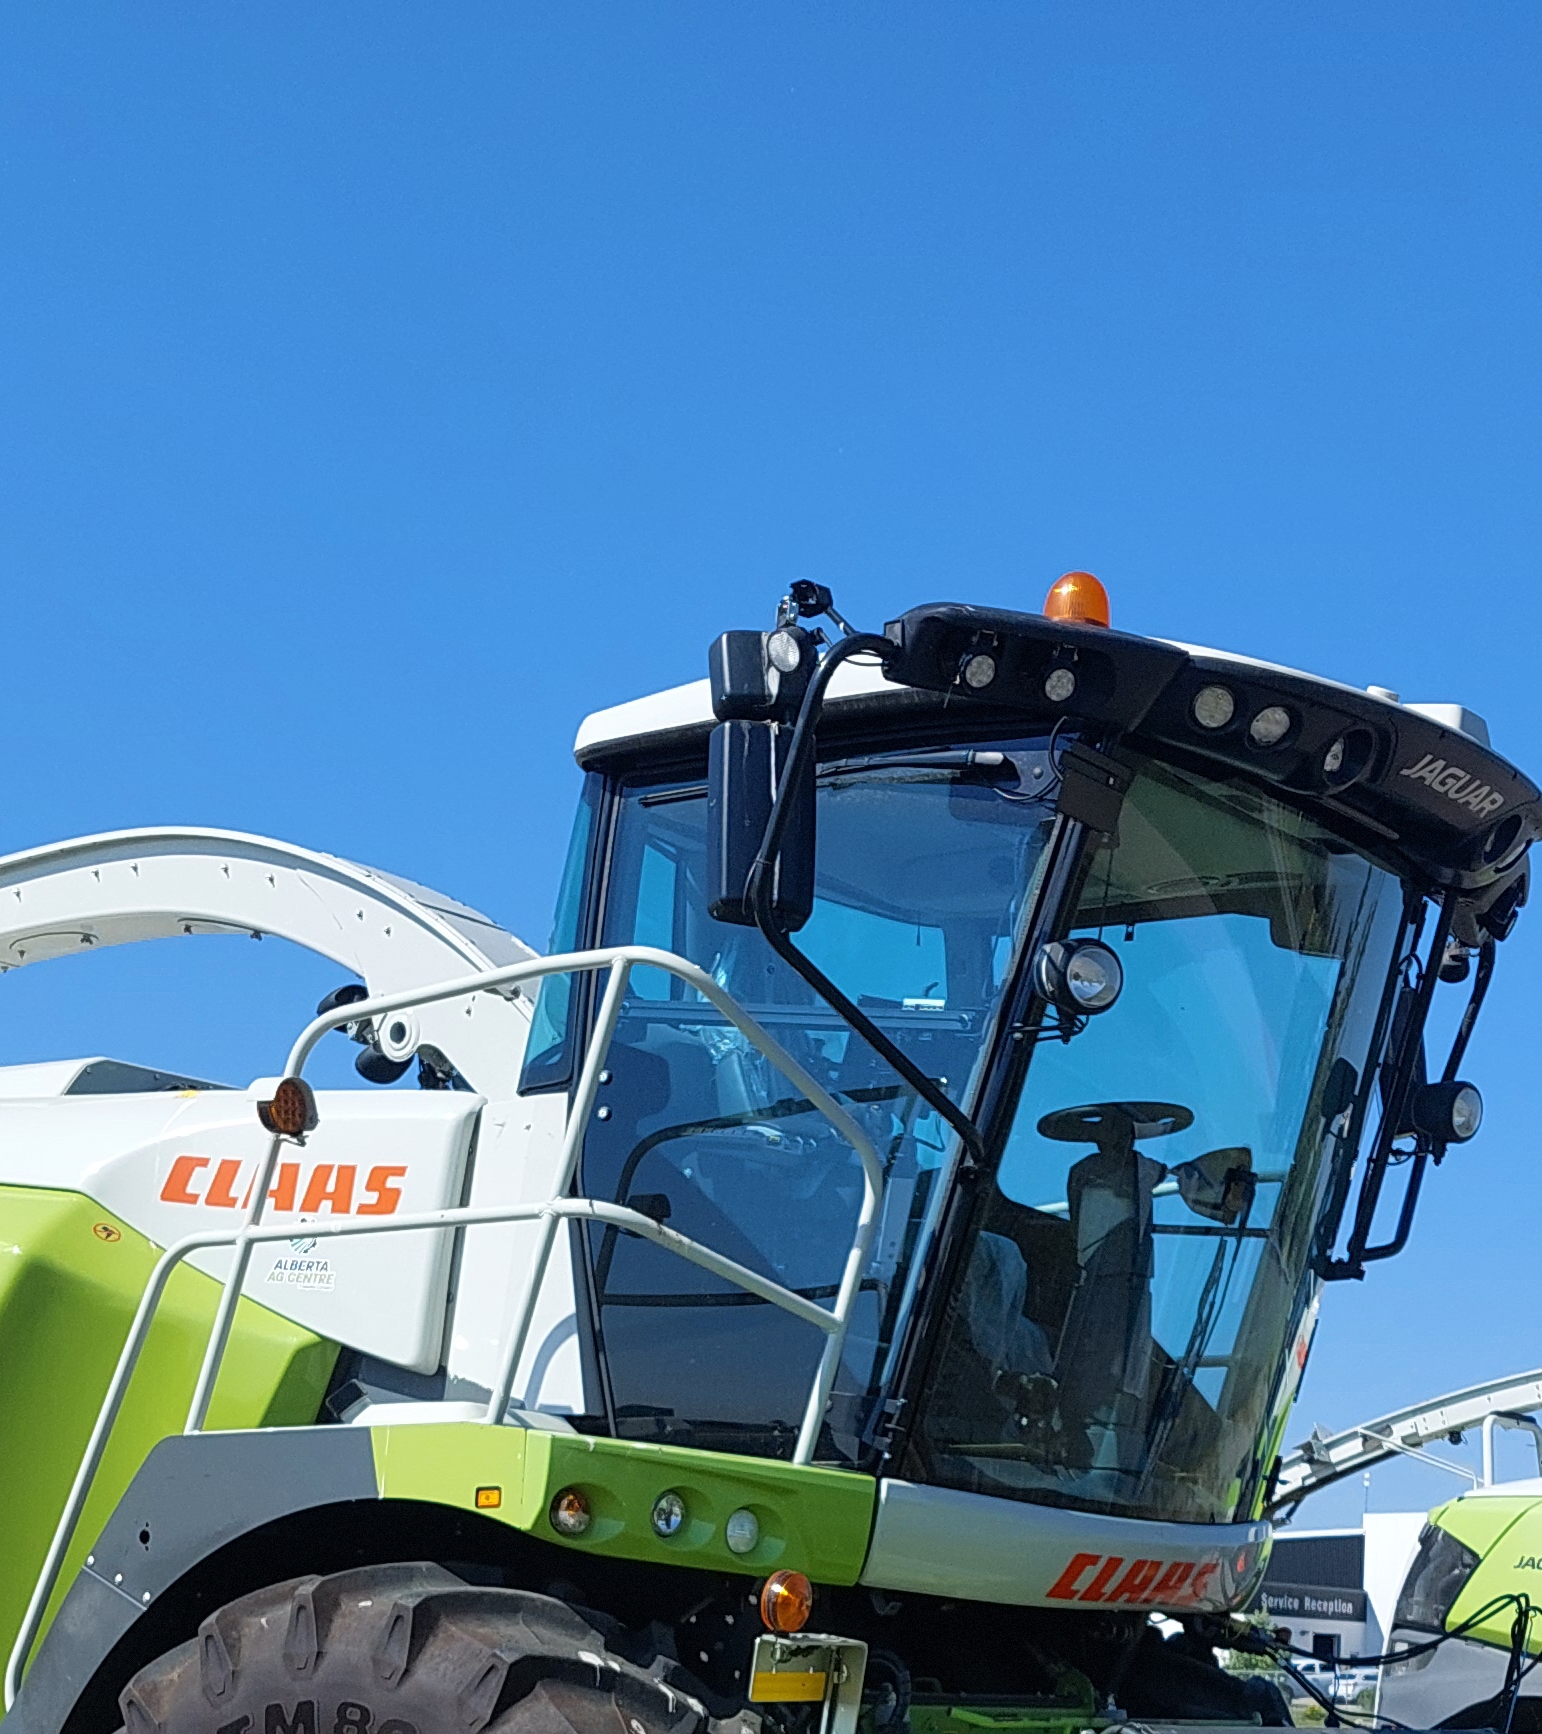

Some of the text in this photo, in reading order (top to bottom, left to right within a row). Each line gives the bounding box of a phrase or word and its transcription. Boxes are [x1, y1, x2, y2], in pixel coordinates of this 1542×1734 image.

[1399, 754, 1504, 818] JAGUAR
[160, 1155, 408, 1215] CLAAS
[274, 1259, 328, 1272] ALBERTA
[267, 1271, 334, 1285] AG CENTRE
[1261, 1592, 1353, 1615] Service Reception
